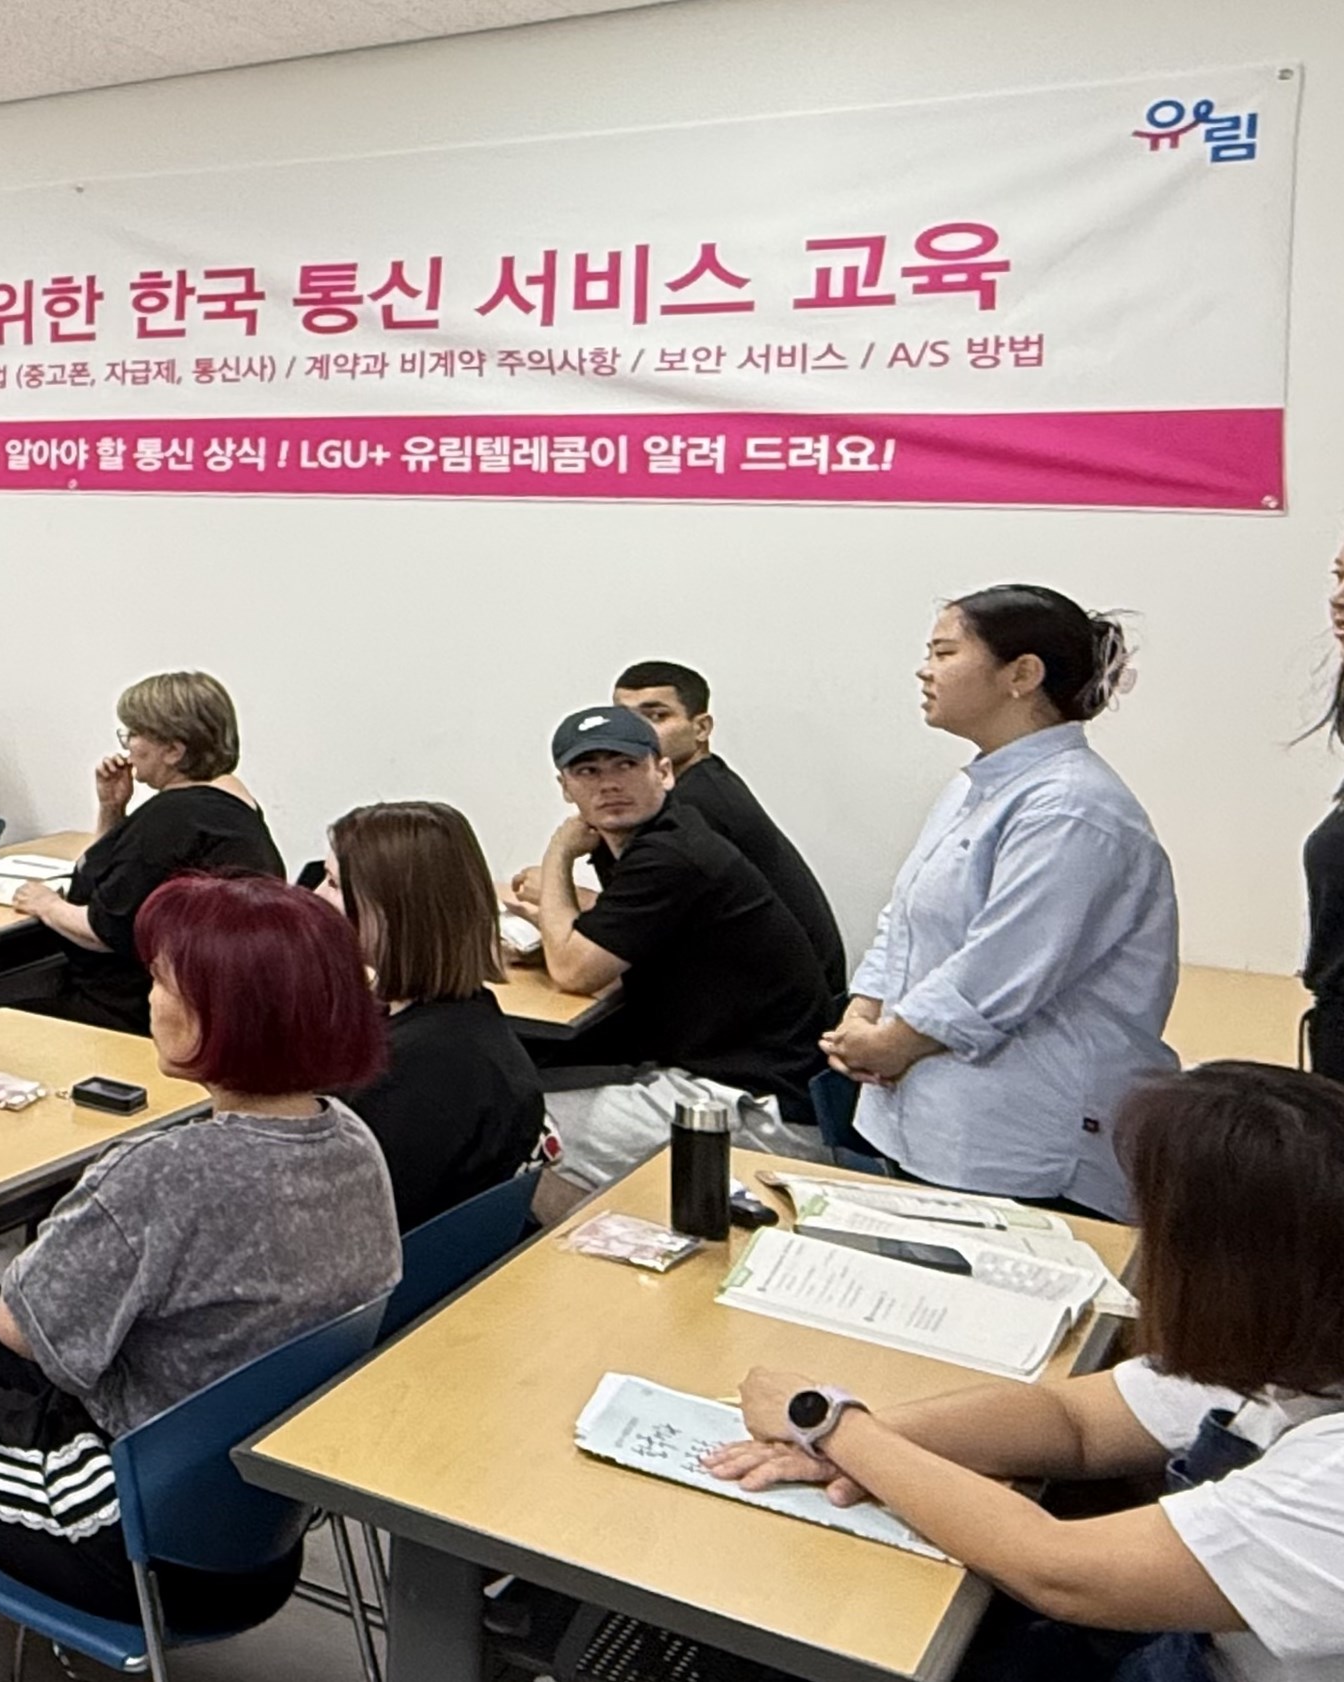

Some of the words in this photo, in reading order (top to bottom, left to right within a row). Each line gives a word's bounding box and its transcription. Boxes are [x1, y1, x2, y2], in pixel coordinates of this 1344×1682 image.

[1131, 99, 1258, 163] 유림
[129, 266, 266, 340] 한국
[292, 255, 444, 335] 통신
[473, 243, 755, 328] 서비스
[792, 221, 1011, 312] 교육
[15, 361, 97, 391] (중고폰,
[104, 358, 183, 386] 자급제,
[191, 354, 277, 384] 통신사)
[304, 350, 390, 382] 계약과
[399, 348, 488, 379] 비계약
[496, 345, 623, 377] 주의사항
[653, 343, 728, 374] 보안
[735, 341, 849, 375] 서비스
[886, 338, 951, 370] A/S
[965, 332, 1046, 371] 방법
[4, 437, 91, 472] 알아야
[96, 436, 127, 472] 할
[132, 437, 195, 472] 통신
[203, 436, 267, 472] 상식
[299, 438, 392, 469] LGU+
[400, 434, 629, 475] 유림텔레콤이
[642, 434, 727, 475] 알려
[739, 433, 897, 476] 드려요!
